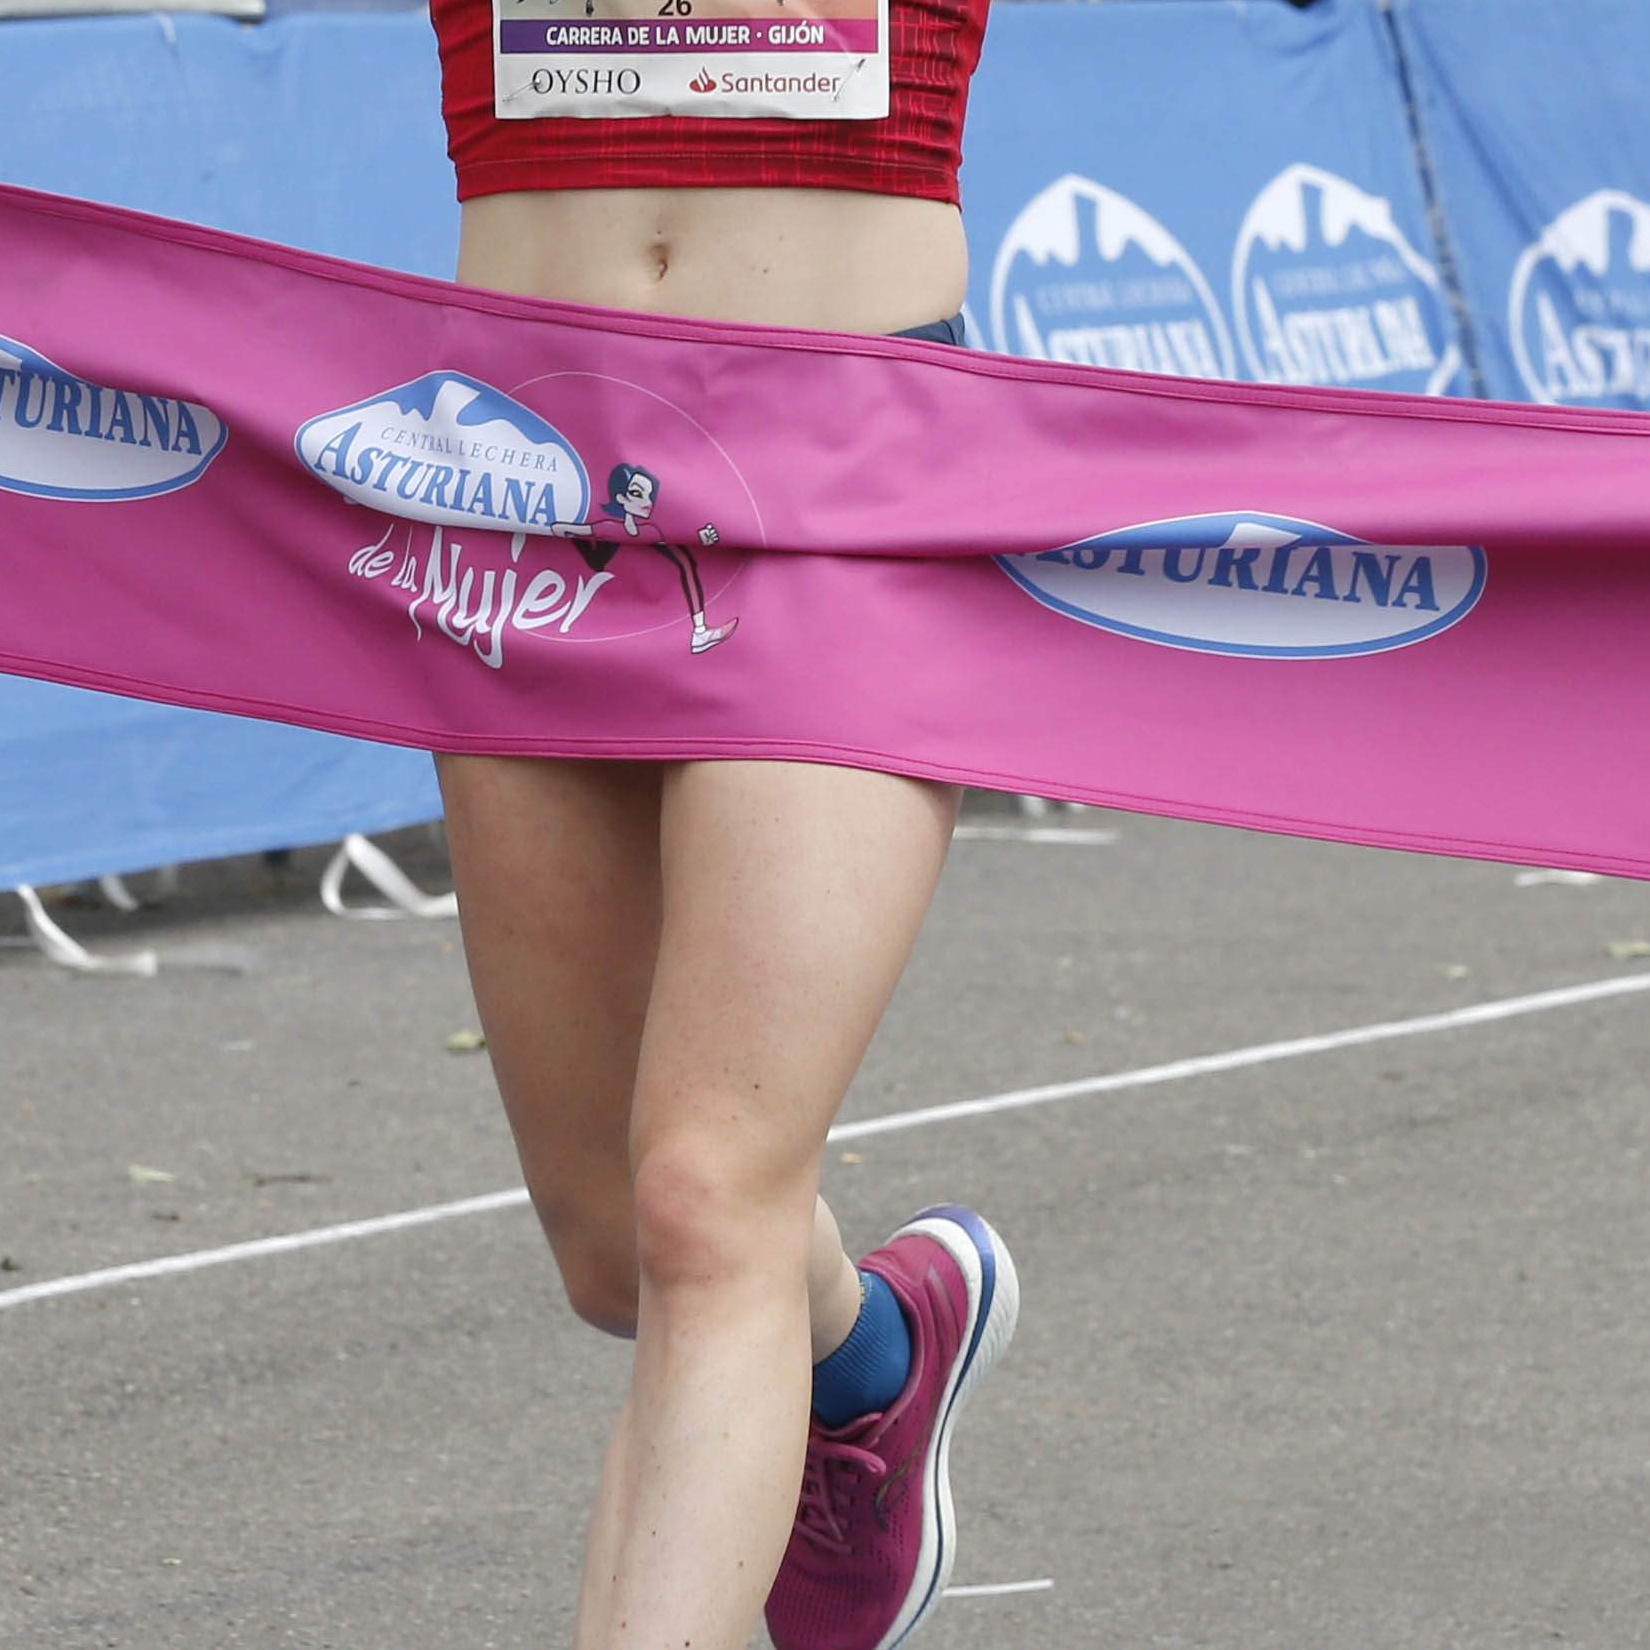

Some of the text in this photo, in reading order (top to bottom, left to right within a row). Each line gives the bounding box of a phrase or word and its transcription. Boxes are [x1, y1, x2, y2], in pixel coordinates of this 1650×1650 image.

[546, 21, 824, 46] CARRERA DE LA MUJER GIJÓN
[531, 68, 642, 94] OYSHO
[721, 72, 841, 94] Santander
[380, 425, 559, 474] CENTRAL LECHERA
[313, 421, 559, 528] ASTURIANA
[348, 522, 615, 670] de la Mujer
